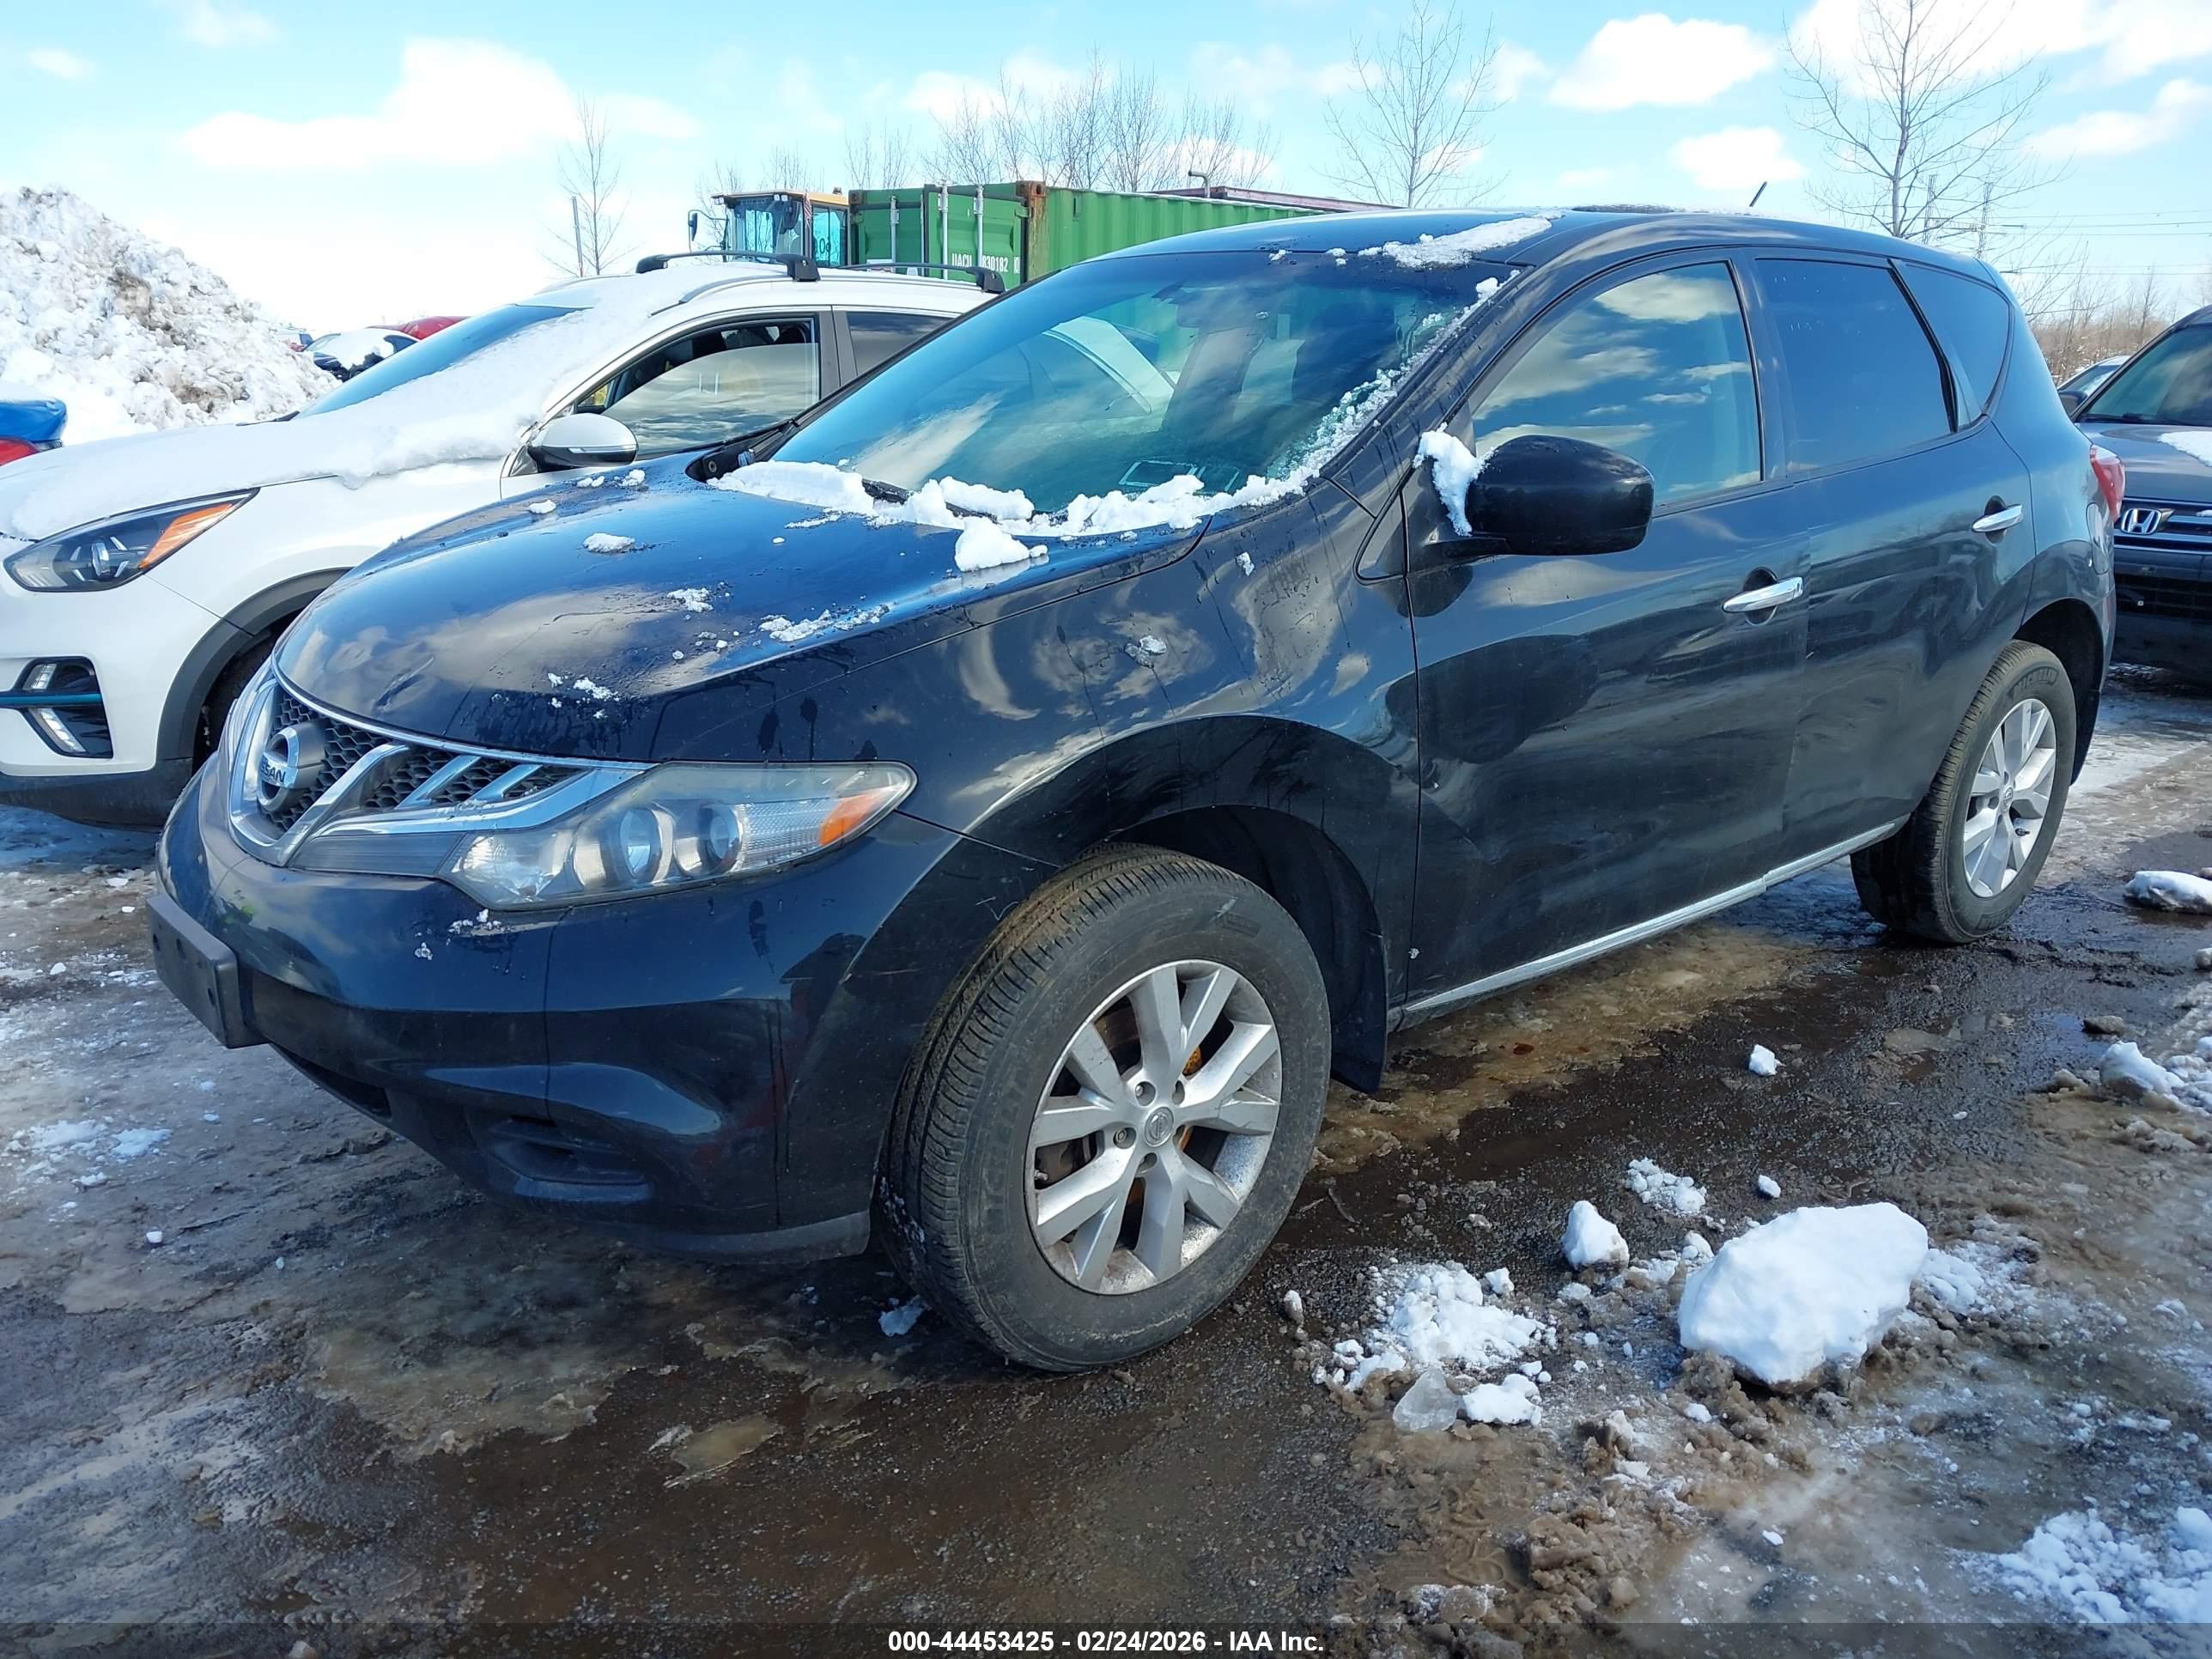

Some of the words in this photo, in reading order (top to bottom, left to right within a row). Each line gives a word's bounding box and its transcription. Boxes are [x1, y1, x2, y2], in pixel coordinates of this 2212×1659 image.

[952, 252, 972, 267] UACU
[981, 255, 1008, 272] 830182
[259, 763, 287, 783] SSAN
